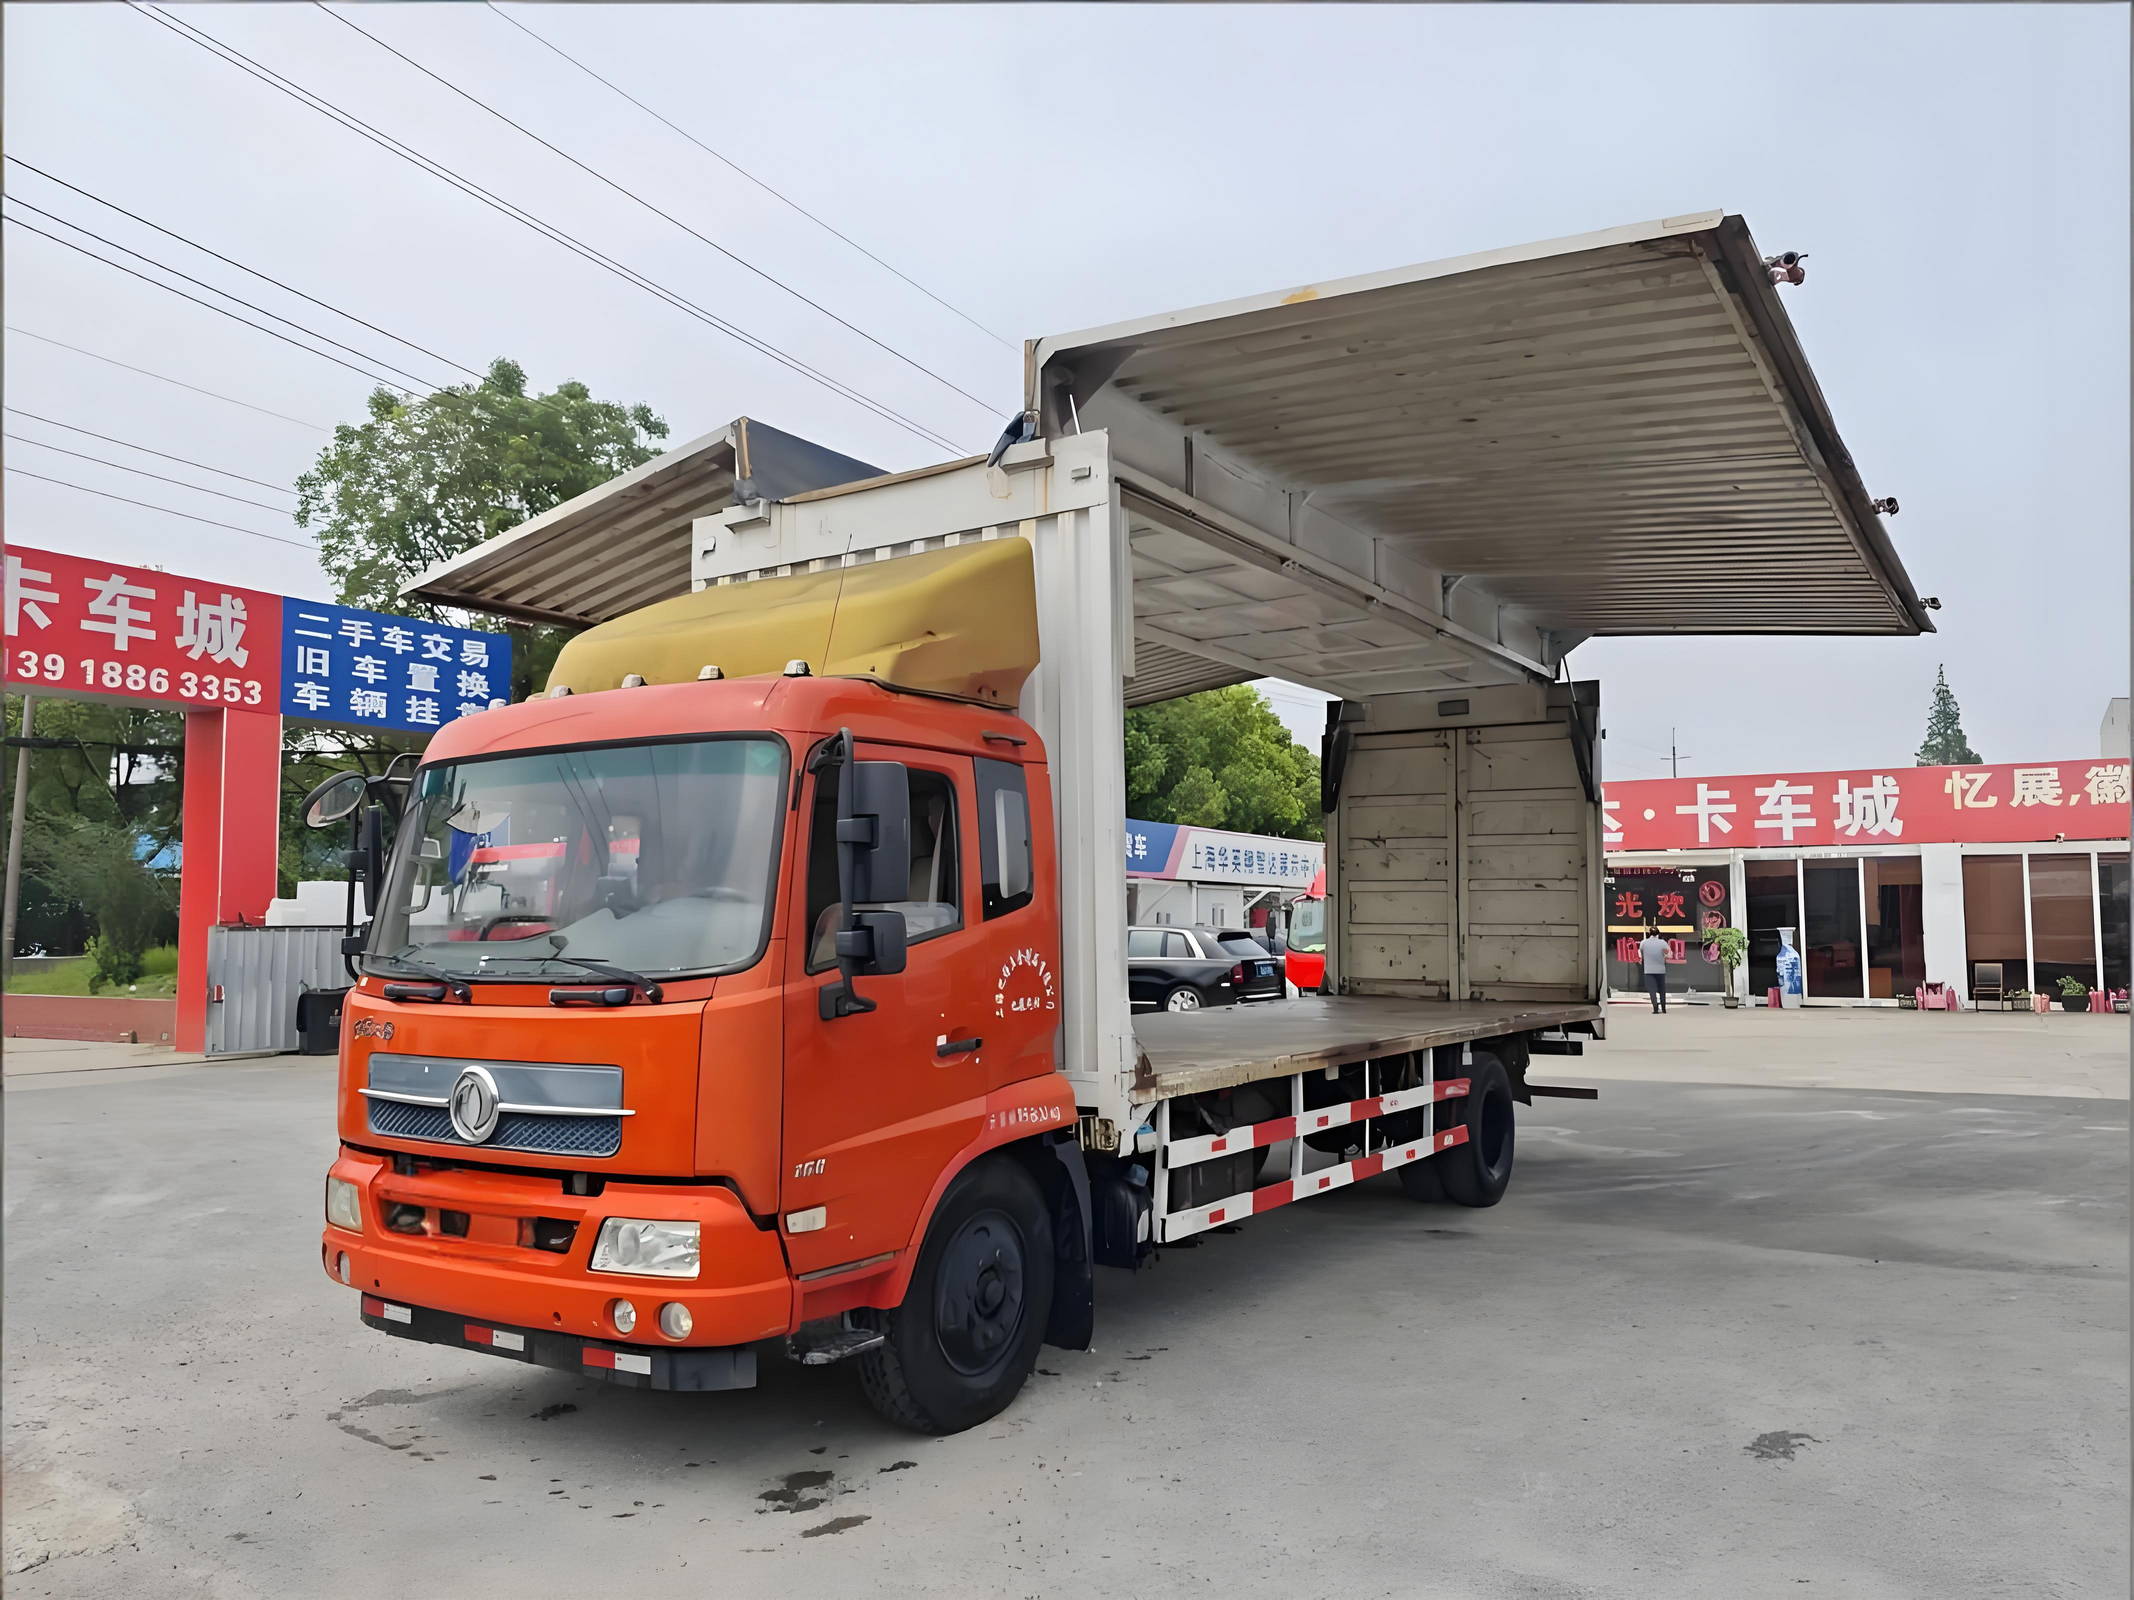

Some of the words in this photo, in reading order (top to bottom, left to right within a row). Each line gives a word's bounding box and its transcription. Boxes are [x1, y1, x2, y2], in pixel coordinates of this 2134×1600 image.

[294, 612, 489, 668] 二手车交易
[5, 648, 65, 681] 39
[80, 658, 170, 694] 1886
[178, 671, 263, 705] 3353
[296, 645, 491, 700] 旧车置换
